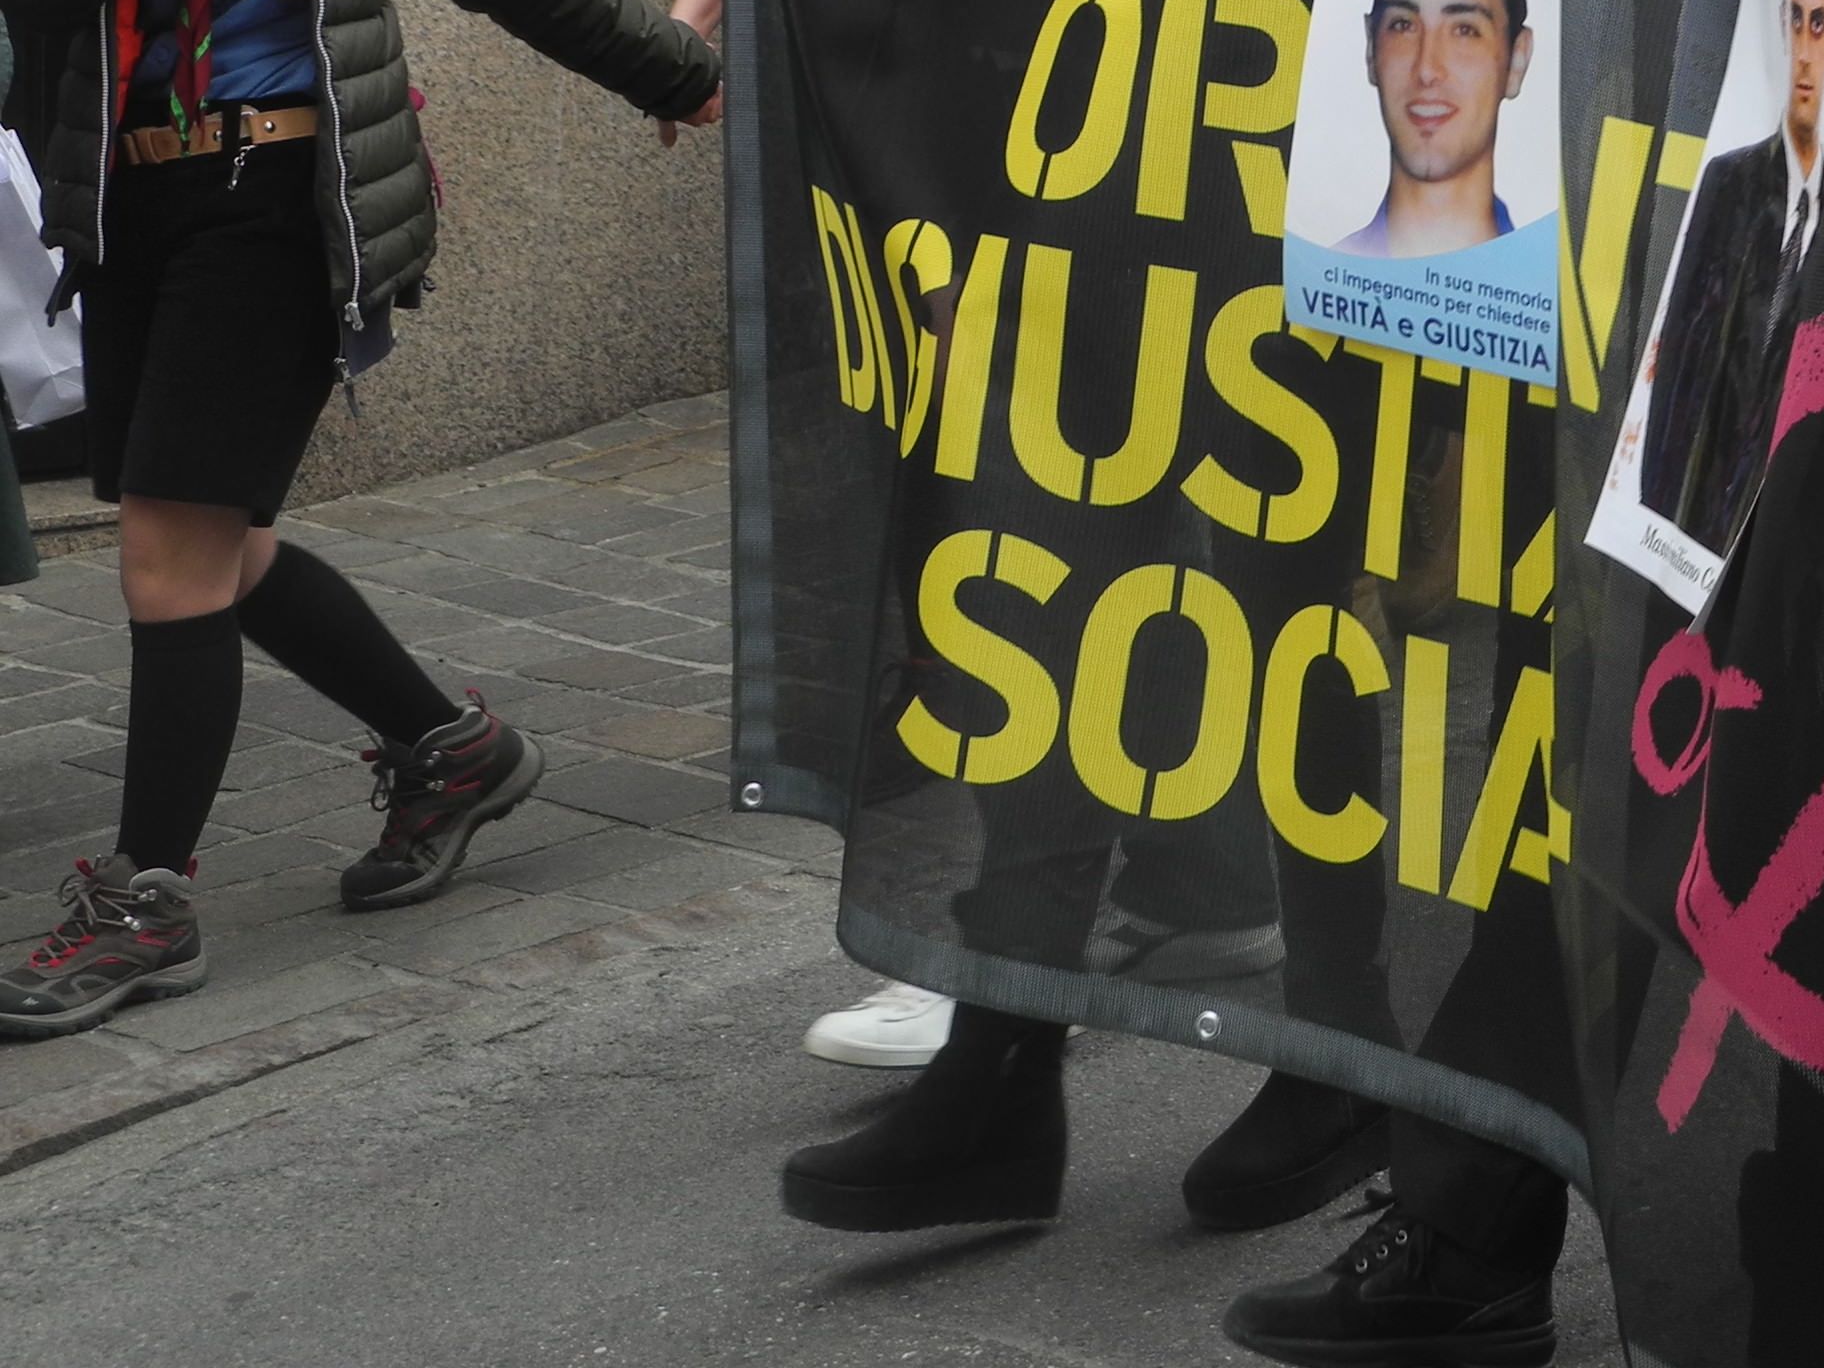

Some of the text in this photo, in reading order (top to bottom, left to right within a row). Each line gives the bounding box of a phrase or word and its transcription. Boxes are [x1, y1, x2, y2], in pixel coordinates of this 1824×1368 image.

[1324, 267, 1551, 334] ci impegnamo per chiedere
[1425, 267, 1553, 312] In sua memoria
[1302, 287, 1551, 372] VERITÀ e GIUSTIZIA
